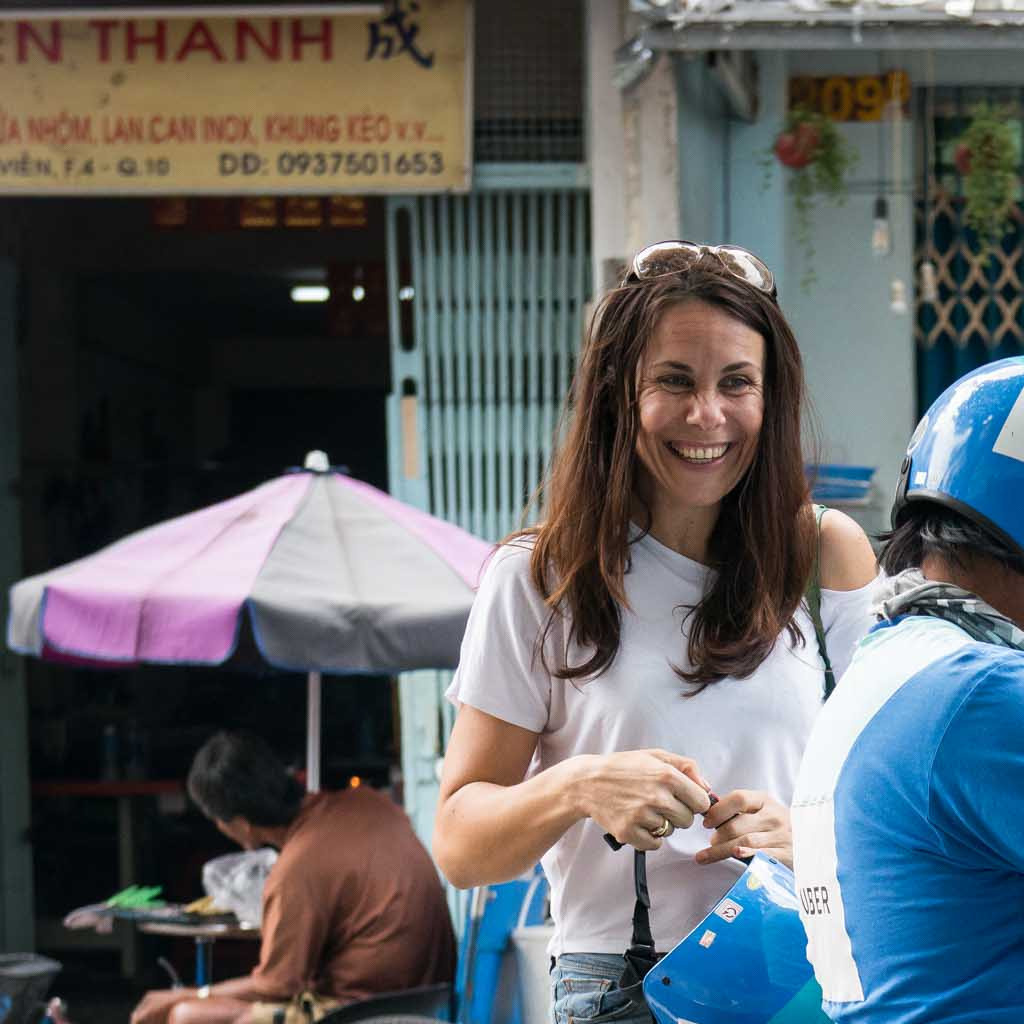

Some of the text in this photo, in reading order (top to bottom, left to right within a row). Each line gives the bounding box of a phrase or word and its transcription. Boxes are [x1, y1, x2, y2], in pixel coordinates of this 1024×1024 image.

[0, 18, 333, 63] N THANH
[366, 0, 434, 68] 成
[103, 116, 144, 144] LAN
[150, 115, 197, 144] CAN
[265, 114, 340, 142] KHUNG
[277, 152, 444, 175] 0937501653
[801, 885, 831, 915] UBER
